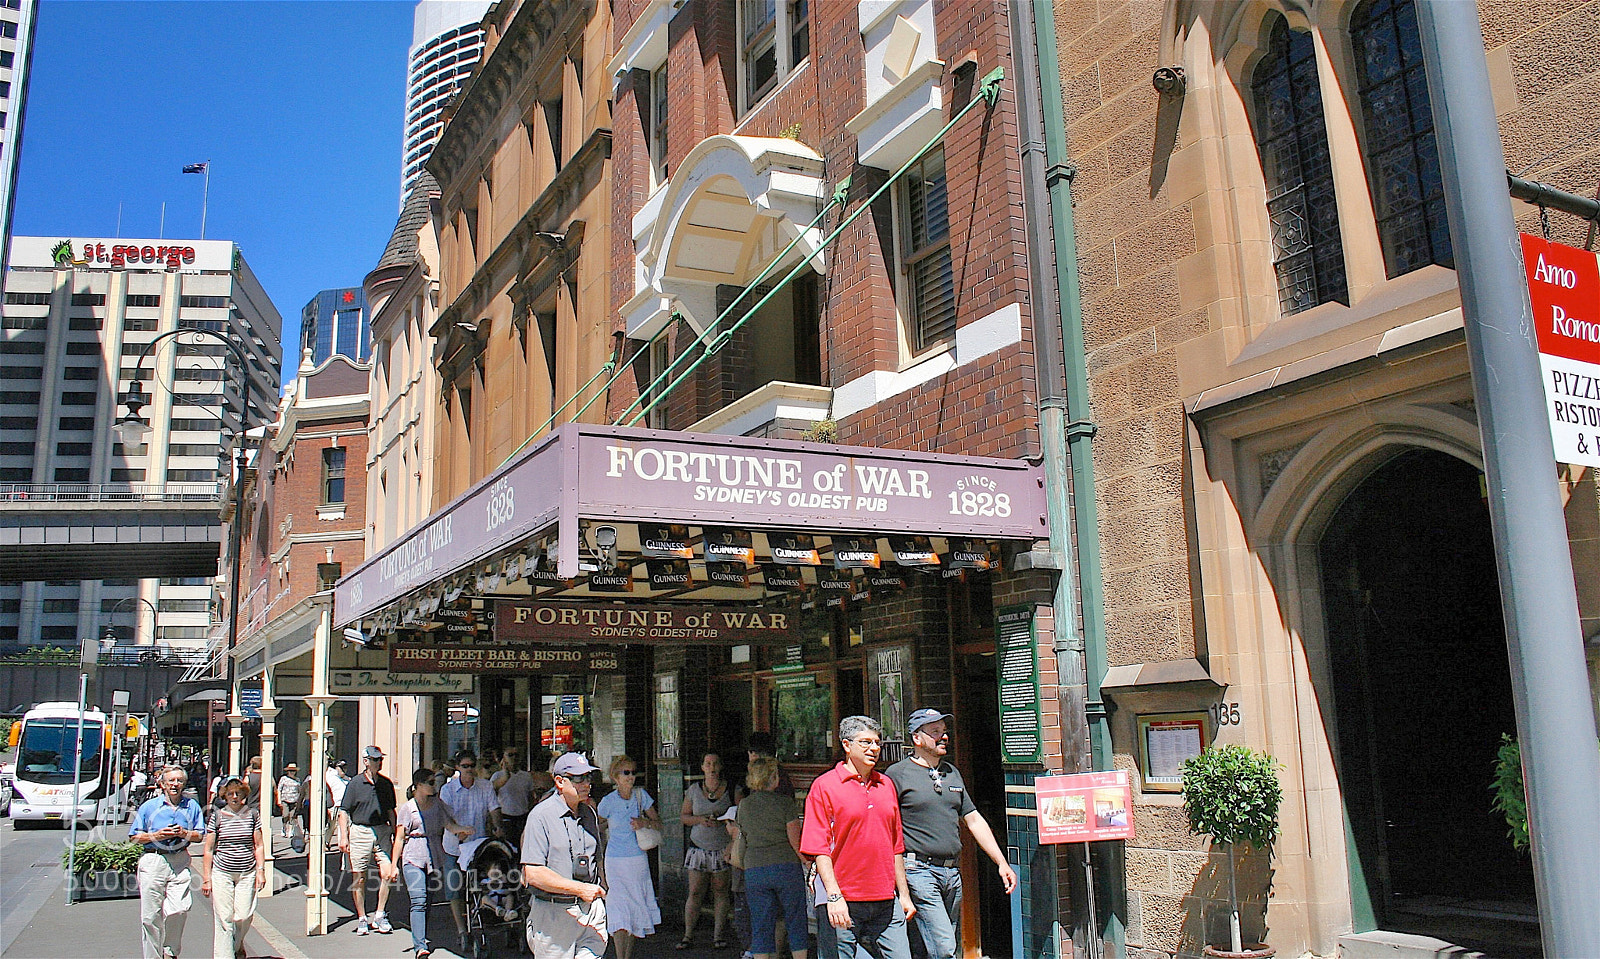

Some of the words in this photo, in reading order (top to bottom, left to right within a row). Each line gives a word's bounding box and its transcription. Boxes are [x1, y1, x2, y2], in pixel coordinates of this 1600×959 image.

[1533, 252, 1576, 289] Amo
[1577, 432, 1589, 455] &
[606, 445, 802, 489] FORTUNE
[813, 463, 847, 492] of
[854, 465, 932, 499] WAR
[490, 476, 508, 498] SINCE
[956, 475, 998, 492] SINCE
[693, 485, 782, 506] SYDNEY'S
[787, 492, 852, 510] OLDEST
[855, 497, 888, 512] PUB
[948, 491, 1011, 518] 1828
[486, 486, 514, 532] 1828
[379, 536, 418, 583] FORTUNE
[430, 514, 453, 553] WAR
[709, 544, 749, 556] GUINNESS
[775, 547, 813, 558] GUINNESS
[838, 551, 874, 561] GUINNESS
[953, 551, 986, 561] GUINNESS
[592, 576, 628, 585] GUINNESS
[653, 573, 688, 583] GUINNESS
[711, 571, 745, 583] GUINNESS
[768, 577, 800, 587] GUINNESS
[871, 577, 900, 586] GUINNESS
[820, 580, 850, 589] GUINNESS
[438, 608, 468, 618] GUINNESS
[513, 607, 673, 628] FORTUNE
[684, 612, 713, 628] of
[721, 612, 788, 630] WAR
[447, 624, 474, 632] GUINNESS
[590, 627, 646, 638] SYDNEY'S
[649, 628, 693, 638] OLDEST
[695, 628, 718, 638] PUB
[395, 648, 438, 660] FIRST
[440, 649, 484, 661] FLEET
[487, 650, 516, 661] BAR
[519, 650, 530, 661] &
[534, 650, 582, 661] BISTRO
[522, 661, 541, 669] PUB
[589, 660, 618, 669] 1828
[357, 672, 378, 687] The
[382, 673, 431, 689] Sheepskin
[434, 673, 463, 689] Shop
[1211, 702, 1241, 726] 135
